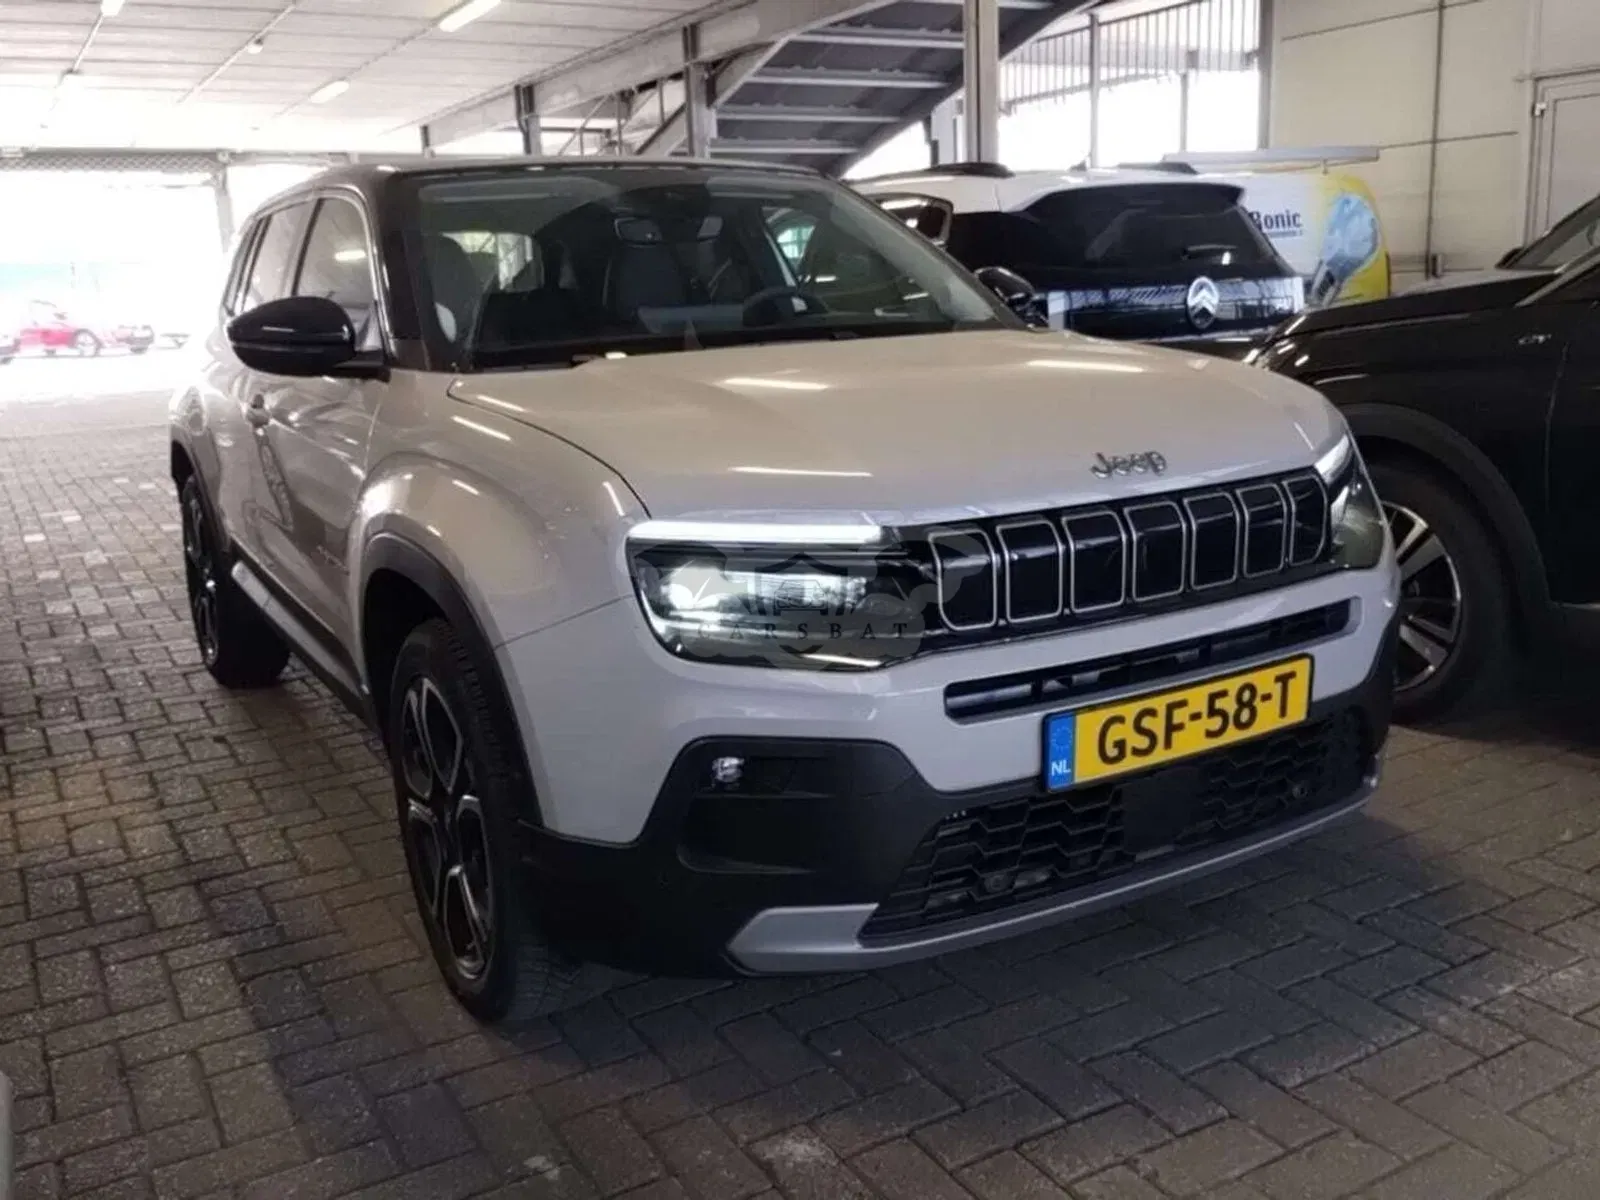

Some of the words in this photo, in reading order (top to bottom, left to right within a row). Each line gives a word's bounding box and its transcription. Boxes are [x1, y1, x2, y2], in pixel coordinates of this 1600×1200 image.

[1090, 450, 1167, 479] Jeep
[1098, 671, 1296, 766] GSF-58-T
[1050, 759, 1072, 776] NL
